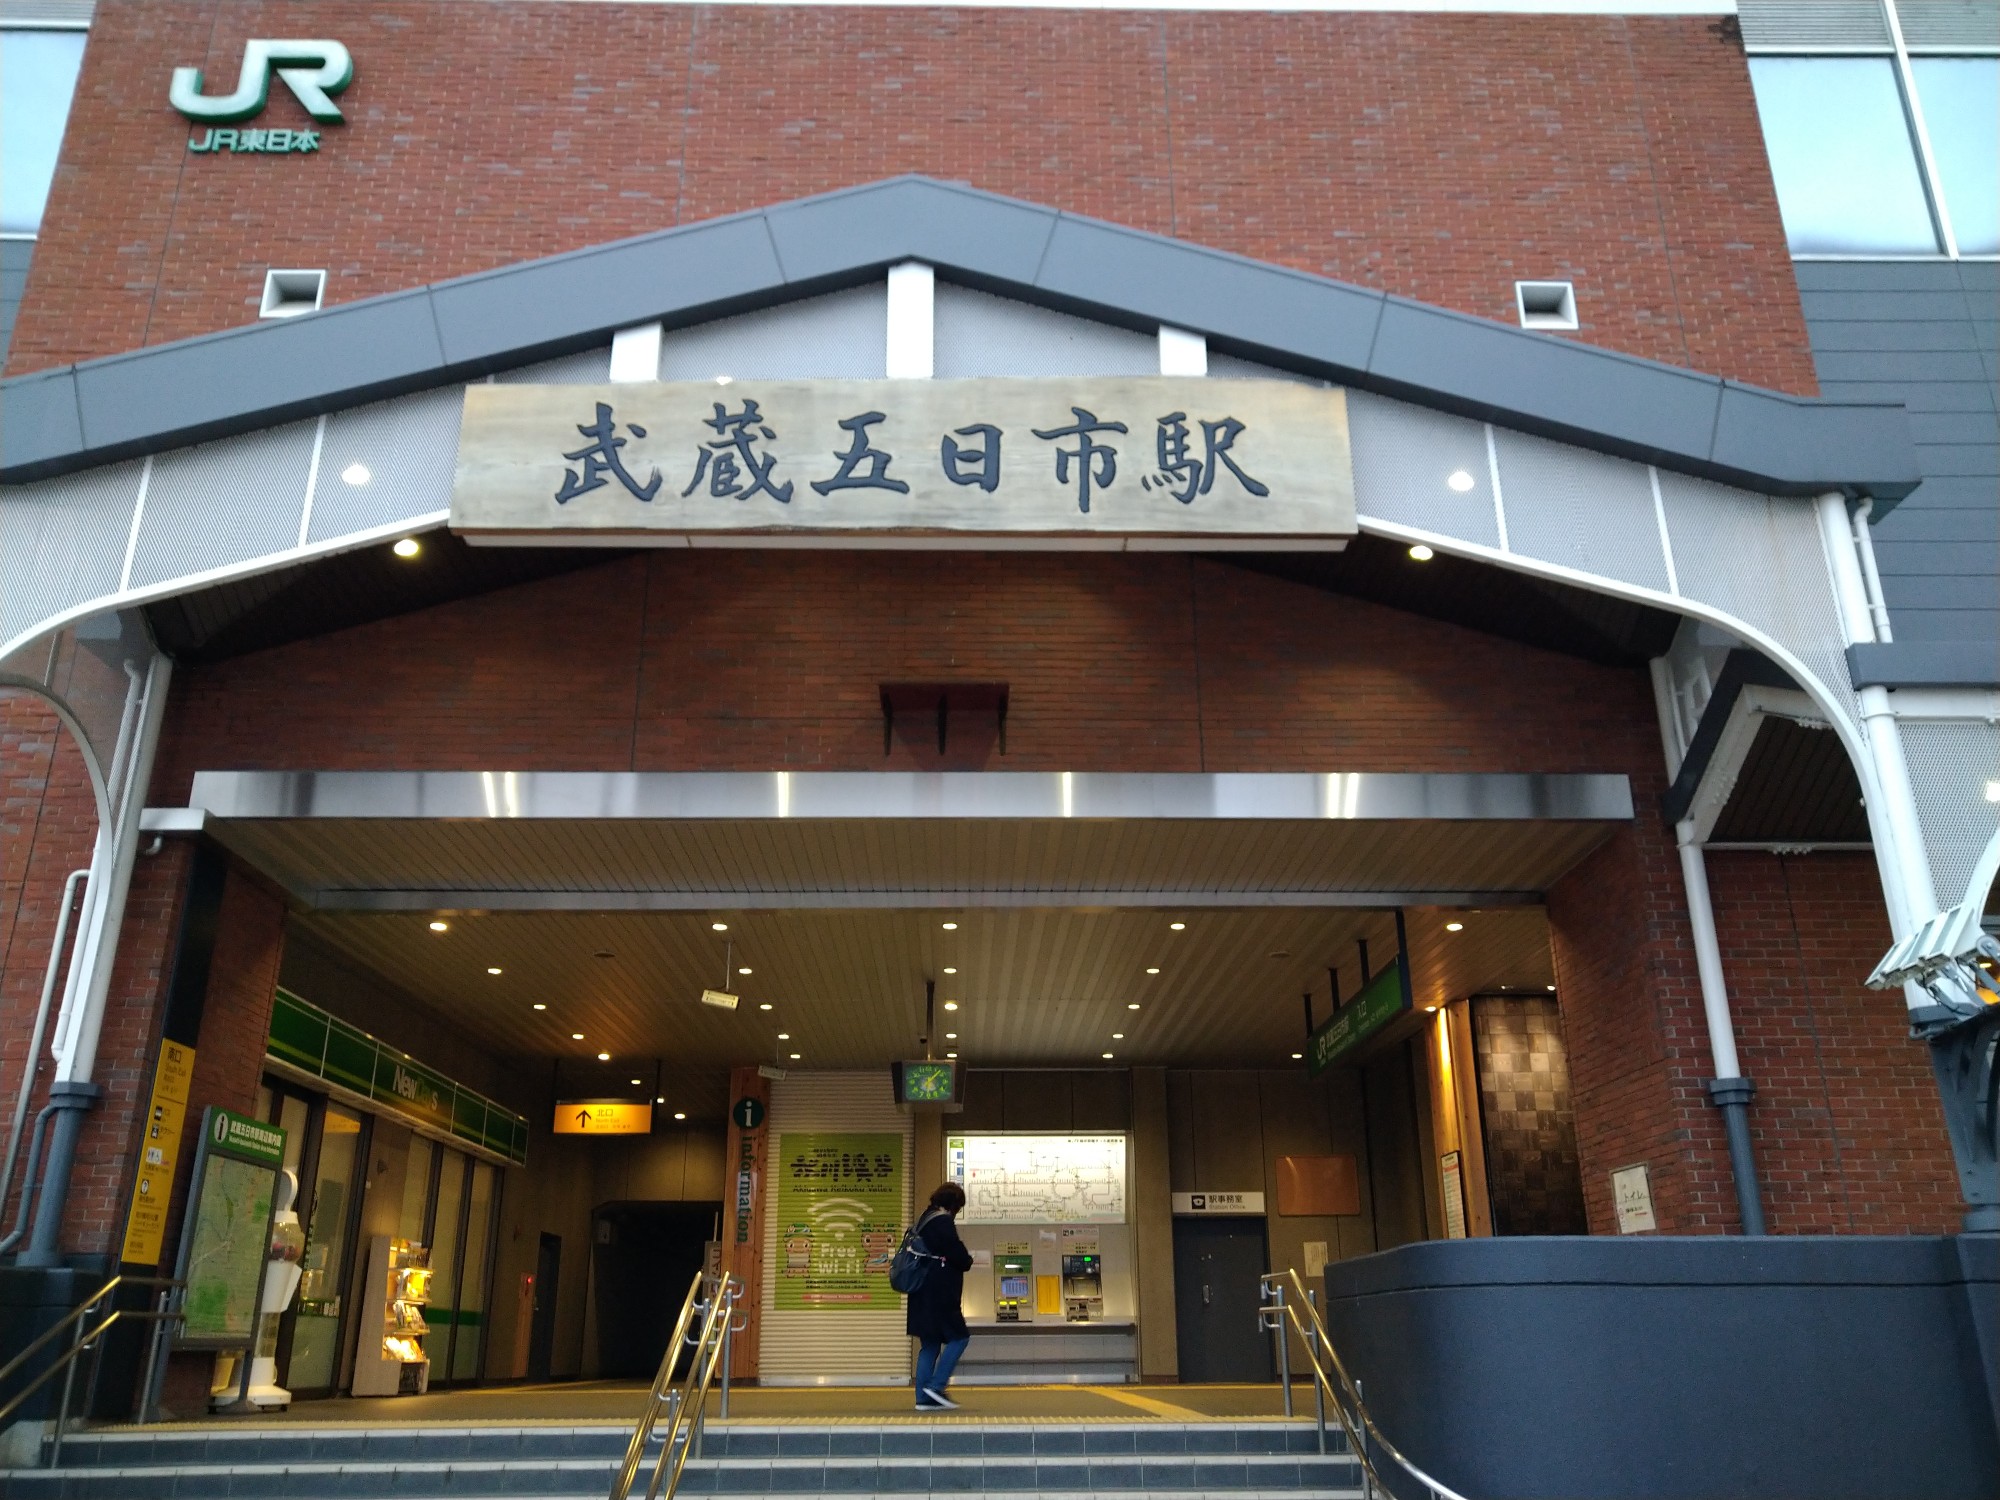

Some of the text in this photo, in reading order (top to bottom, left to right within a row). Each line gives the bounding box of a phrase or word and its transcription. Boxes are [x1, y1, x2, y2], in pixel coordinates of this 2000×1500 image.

[169, 38, 352, 123] JR
[188, 128, 320, 153] JR東日本
[553, 399, 1270, 513] 武蔵五日市駅
[737, 1136, 756, 1243] information
[1209, 1195, 1243, 1203] 駅事務室
[821, 1243, 856, 1257] Free
[819, 1259, 860, 1273] Wi-Fi
